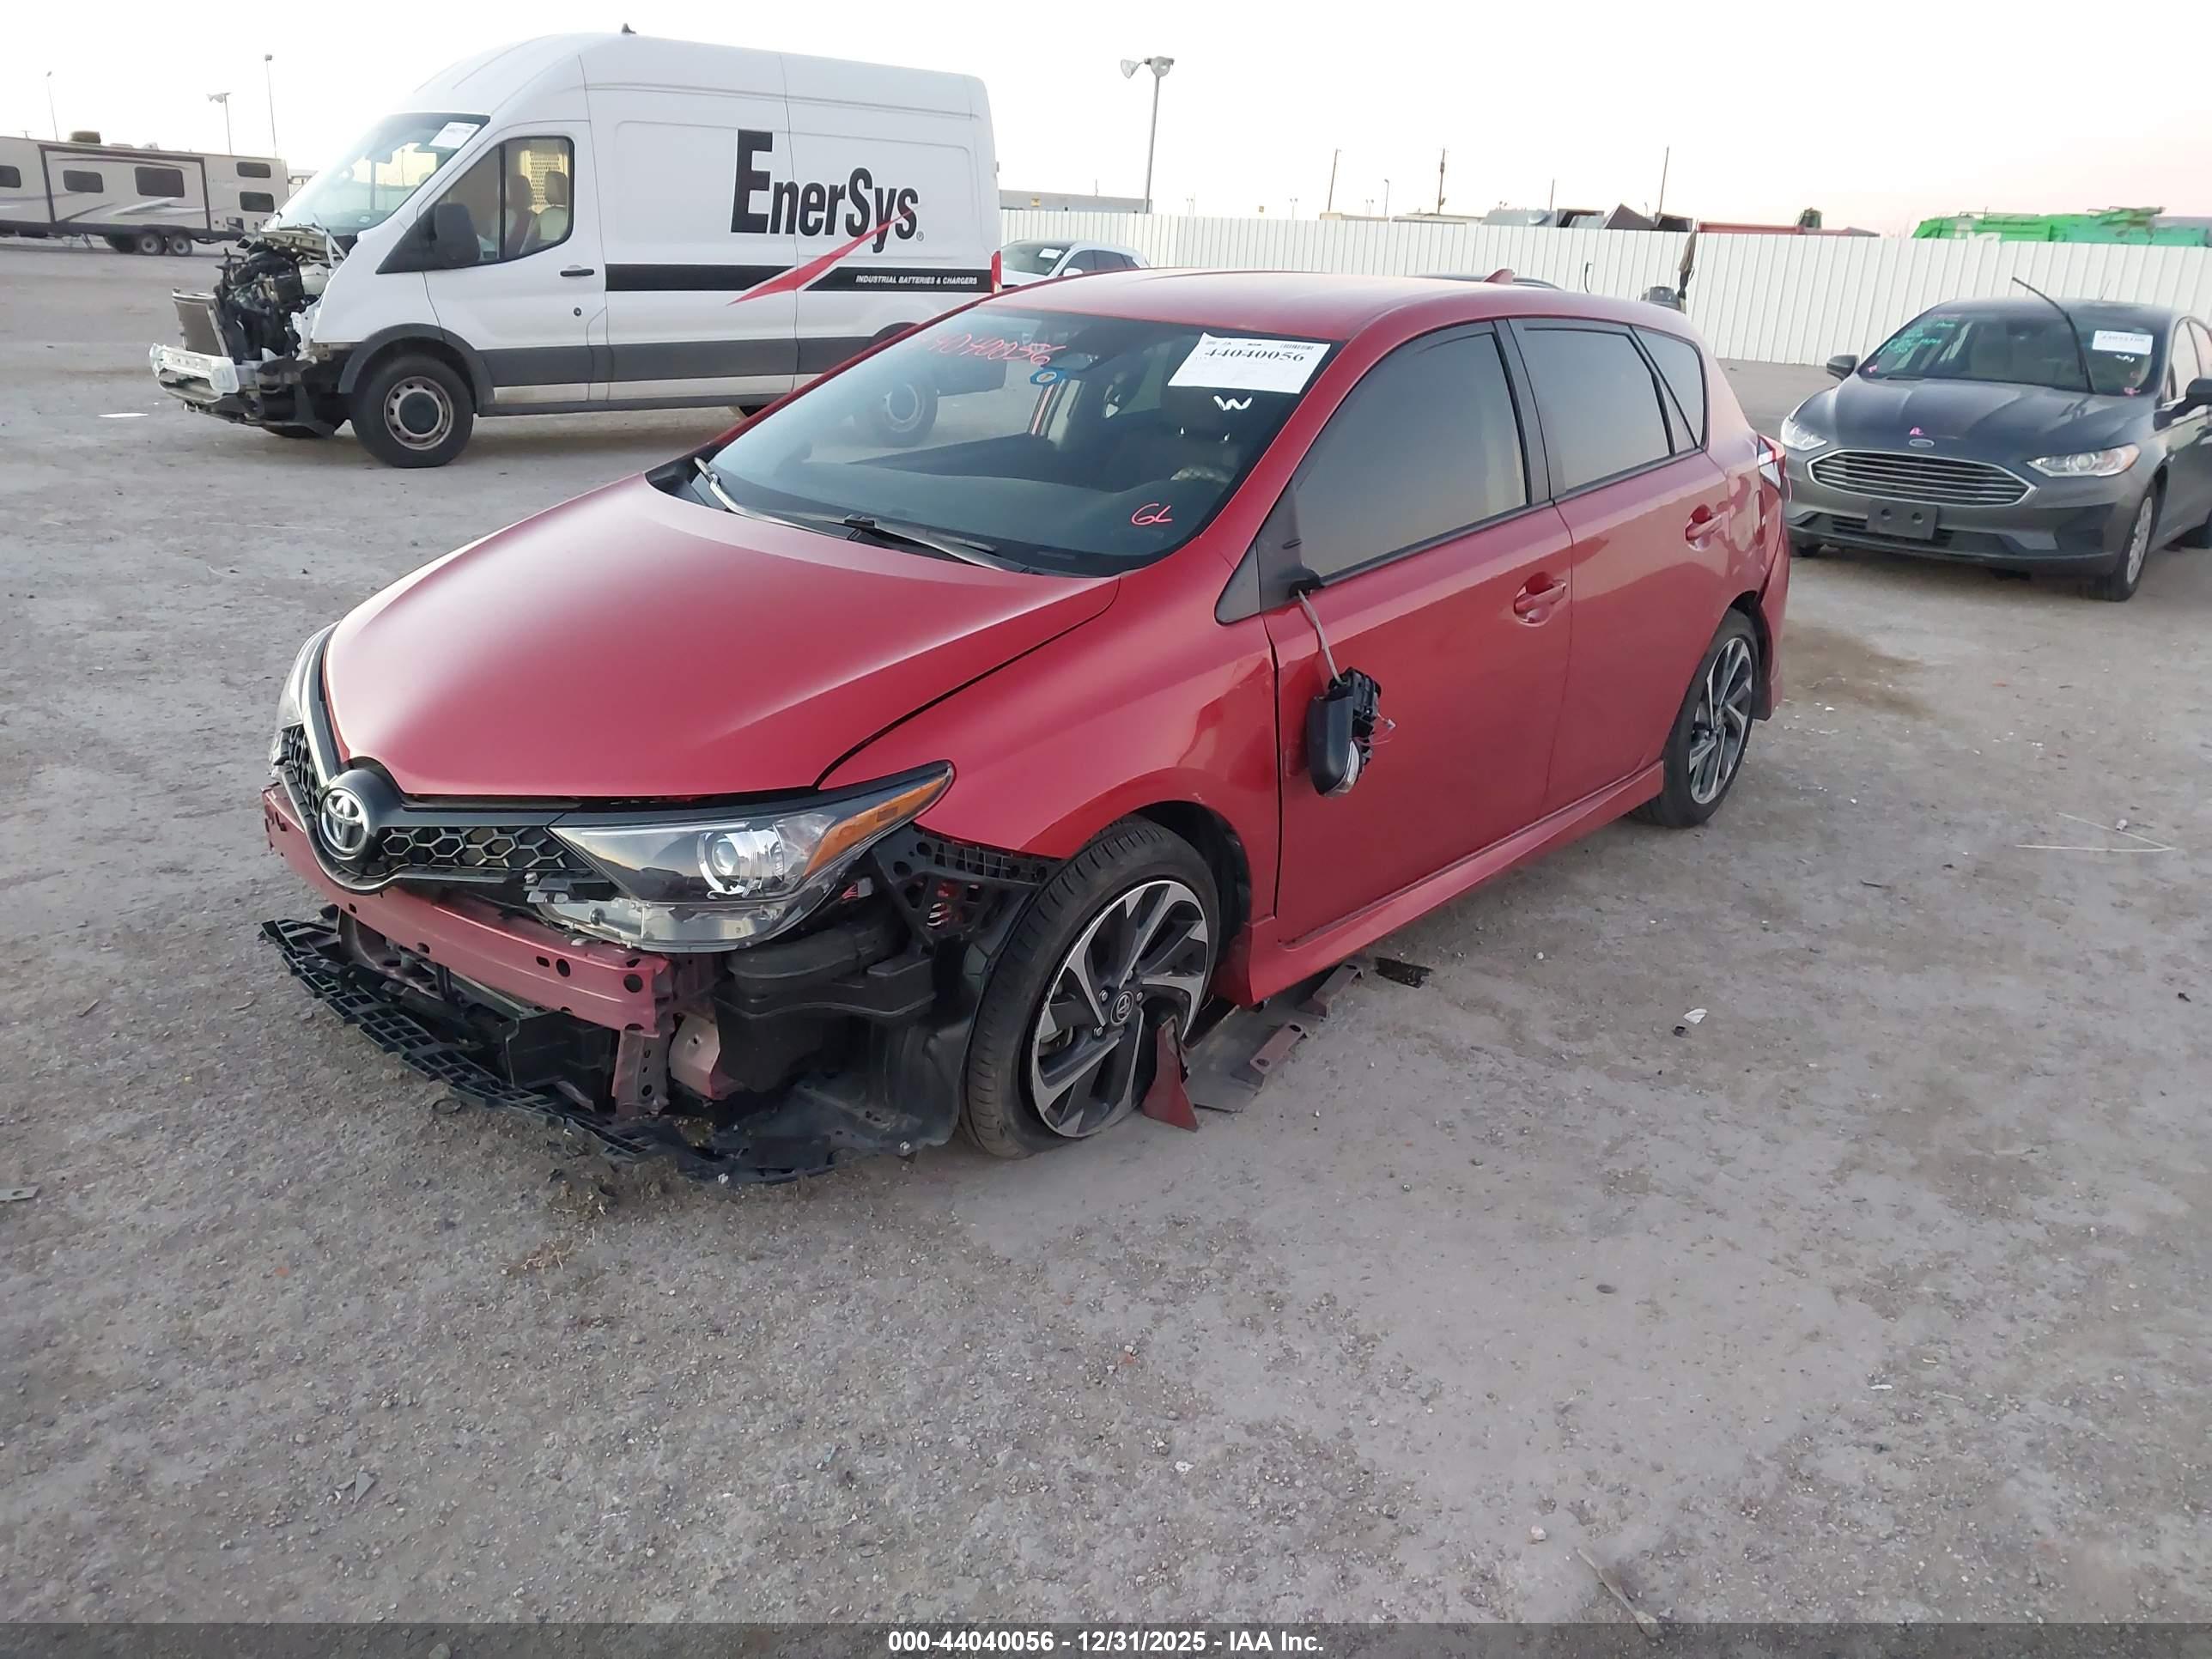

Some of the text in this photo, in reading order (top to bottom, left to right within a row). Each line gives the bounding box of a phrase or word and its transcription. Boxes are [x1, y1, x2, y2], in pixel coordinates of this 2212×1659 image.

[855, 275, 978, 285] INDUSTRIAL BATTERIES & CHARGERS
